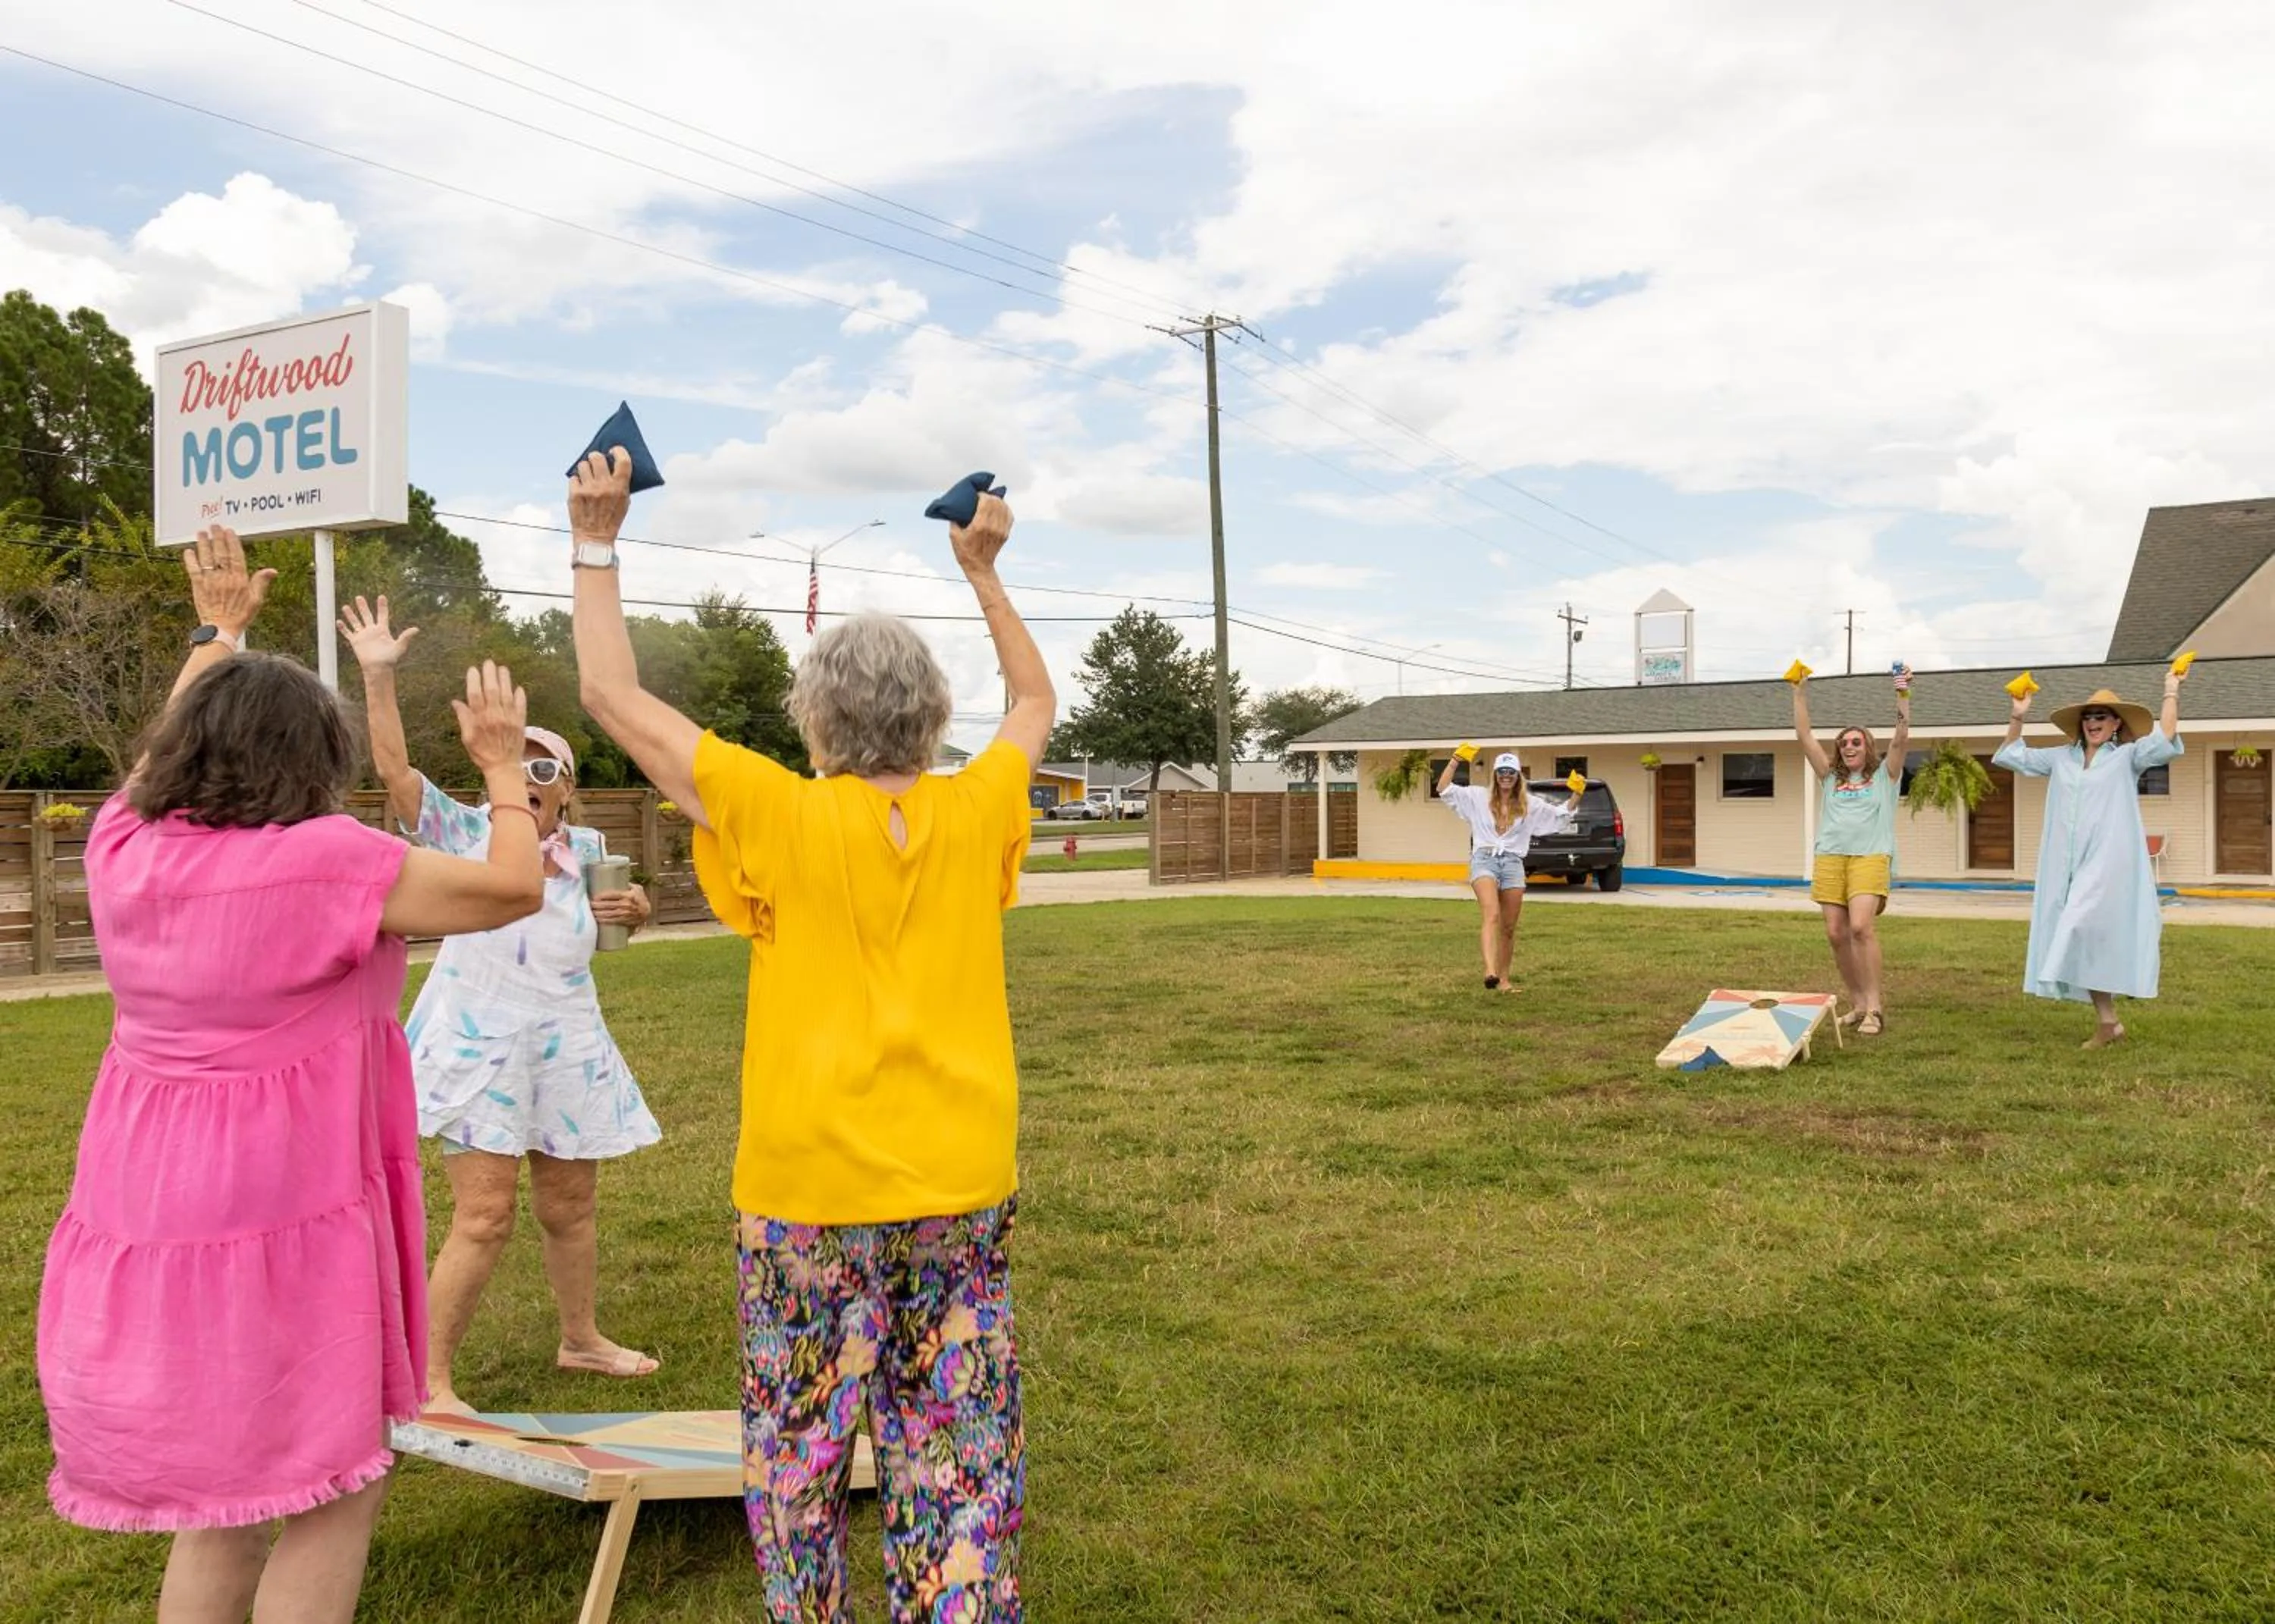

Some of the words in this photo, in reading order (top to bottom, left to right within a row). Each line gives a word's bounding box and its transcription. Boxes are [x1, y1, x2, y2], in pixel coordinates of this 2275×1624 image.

[180, 333, 353, 422] Driftwood
[182, 406, 358, 488] MOTEL
[225, 499, 240, 516] TV
[251, 494, 284, 512] POOL
[295, 488, 322, 506] WIFI
